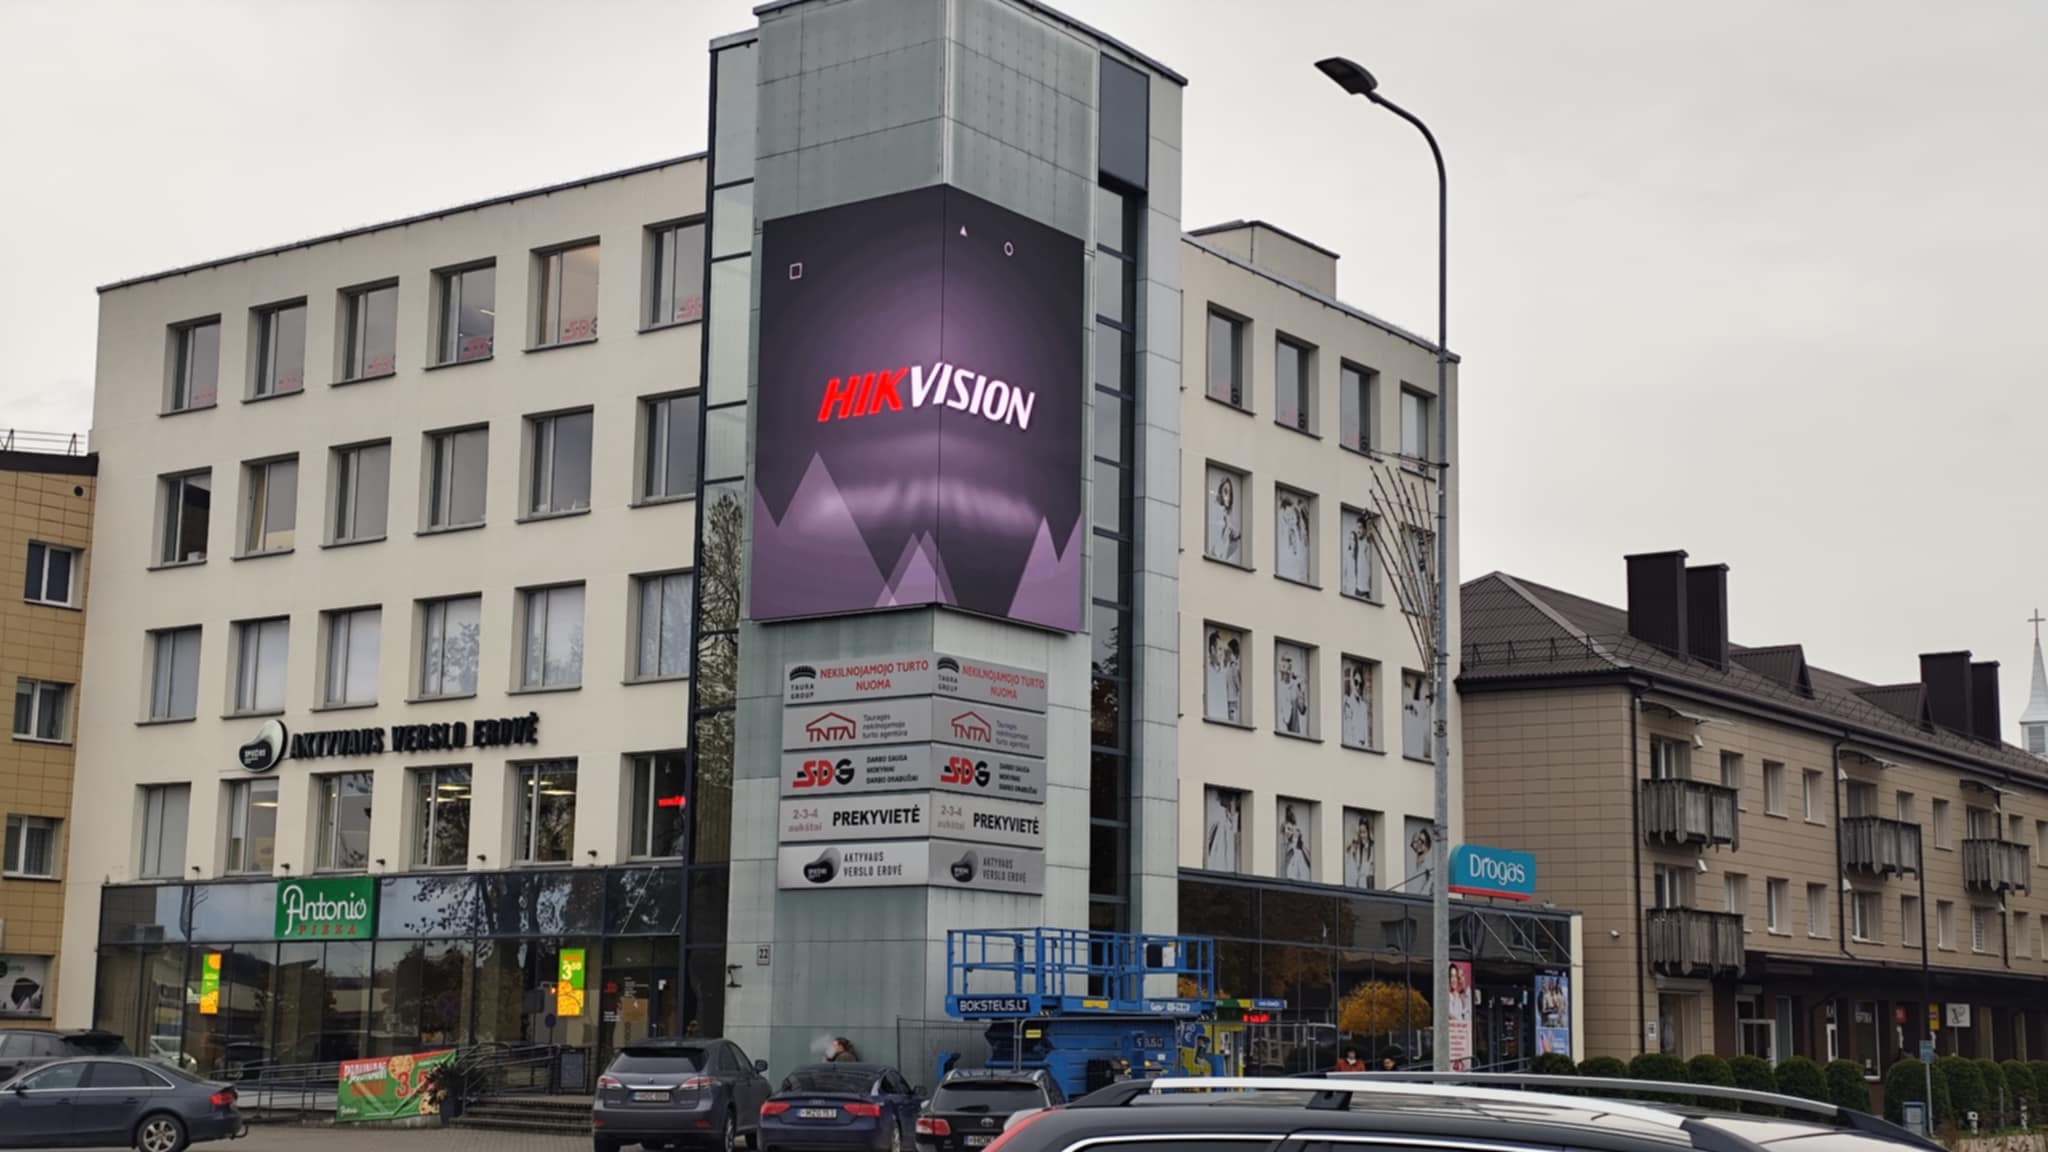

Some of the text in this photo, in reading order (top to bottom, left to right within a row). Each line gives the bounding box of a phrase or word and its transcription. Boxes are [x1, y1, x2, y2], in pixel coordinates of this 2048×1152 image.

[817, 362, 1035, 430] HIKVISION
[820, 660, 929, 678] NEKILNOJAMOJO TURTO
[856, 680, 891, 691] NUOMA
[1021, 675, 1045, 689] TURTO
[991, 687, 1017, 698] NUOMA
[290, 727, 385, 759] AKTYVAUS
[391, 721, 467, 753] VERSLO
[473, 711, 539, 747] ERDVĖ
[792, 758, 855, 788] SDG
[940, 756, 990, 787] SDG
[833, 804, 920, 827] PREKYVIETĖ
[973, 812, 1040, 835] PREKYVIETĖ
[844, 852, 884, 863] AKTYVAUS
[844, 866, 874, 877] VERSLO
[1469, 853, 1526, 886] Drogas
[283, 885, 367, 935] Antonio
[297, 924, 356, 936] PIZZA
[960, 1000, 1028, 1012] BOKSTELIS.LT
